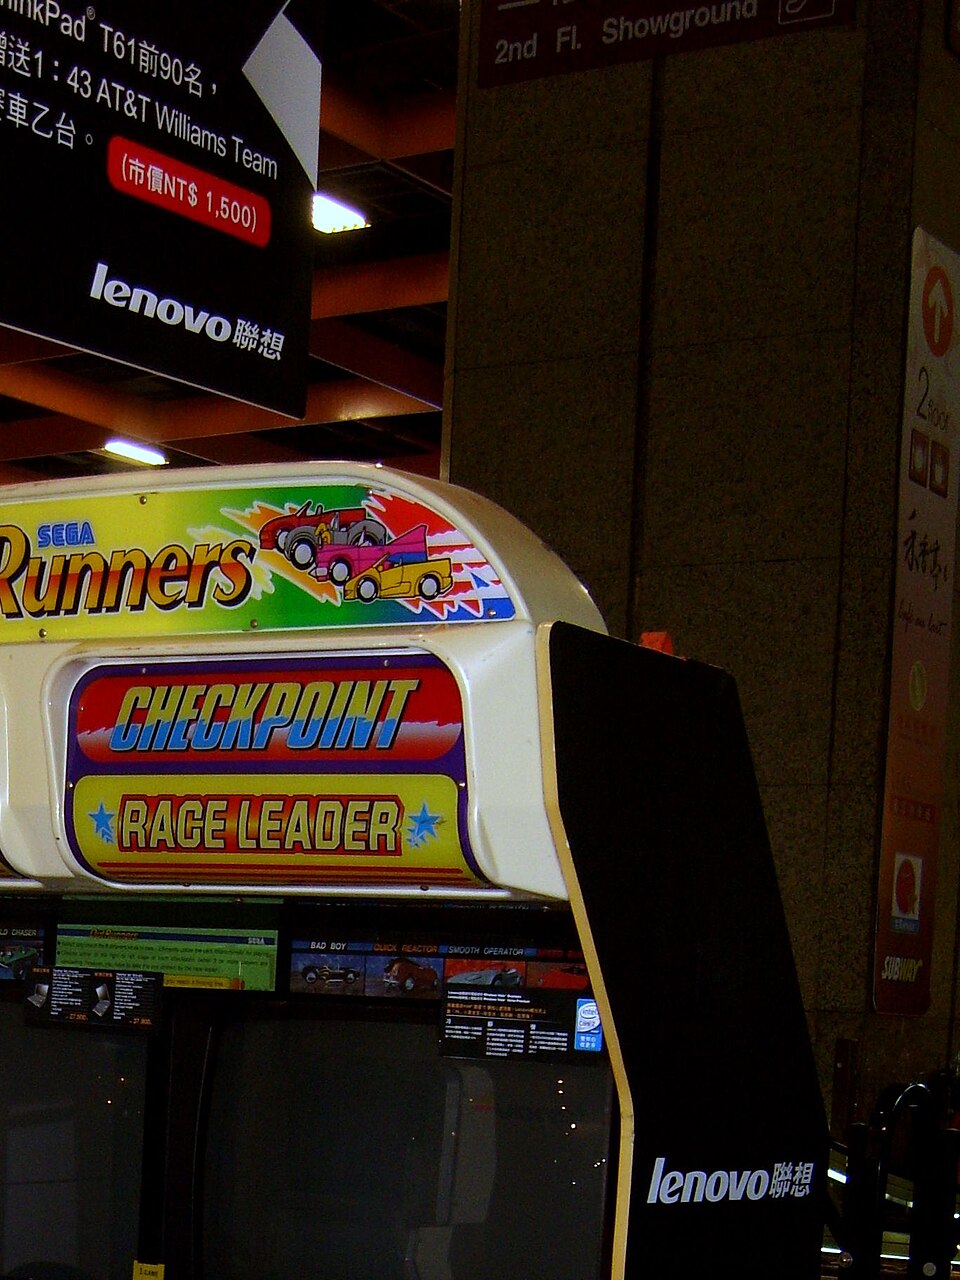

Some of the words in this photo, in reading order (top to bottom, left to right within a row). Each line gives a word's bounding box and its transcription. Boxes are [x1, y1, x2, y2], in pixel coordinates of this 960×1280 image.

[495, 33, 538, 65] 2nd
[555, 25, 582, 53] Fl.
[601, 0, 758, 45] Showground
[96, 78, 151, 123] AT&T
[155, 101, 227, 157] Williams
[232, 136, 278, 181] Team
[37, 520, 96, 547] SEGA
[108, 679, 423, 753] CHECKPOINT
[121, 799, 226, 850] RACE
[237, 799, 401, 850] LEADER
